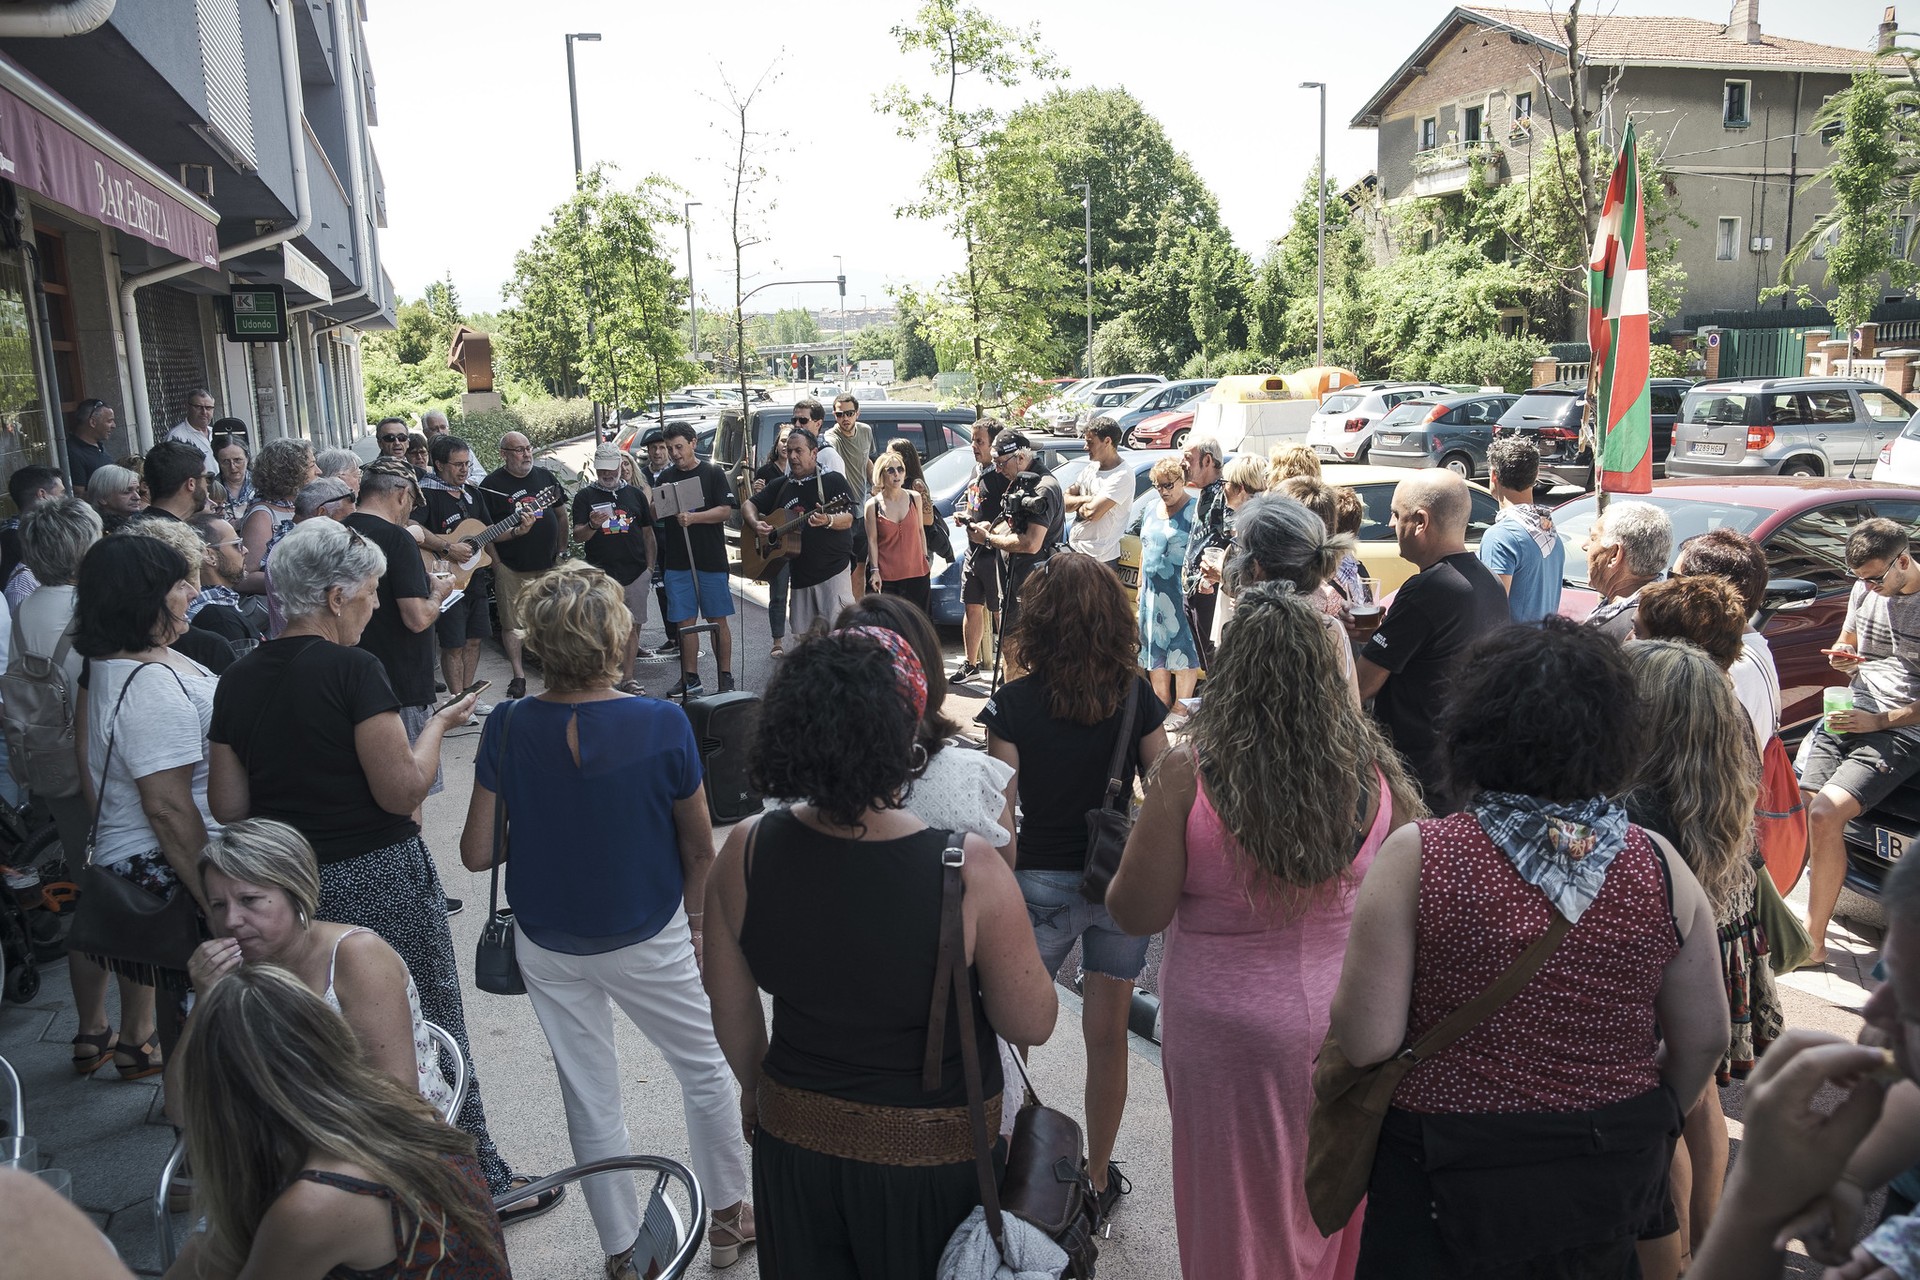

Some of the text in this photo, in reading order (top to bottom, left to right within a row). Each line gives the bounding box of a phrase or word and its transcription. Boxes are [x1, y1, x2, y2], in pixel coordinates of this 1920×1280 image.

[94, 160, 170, 242] BAR ERETZA
[242, 319, 272, 329] Udondo
[1695, 443, 1710, 452] 2289
